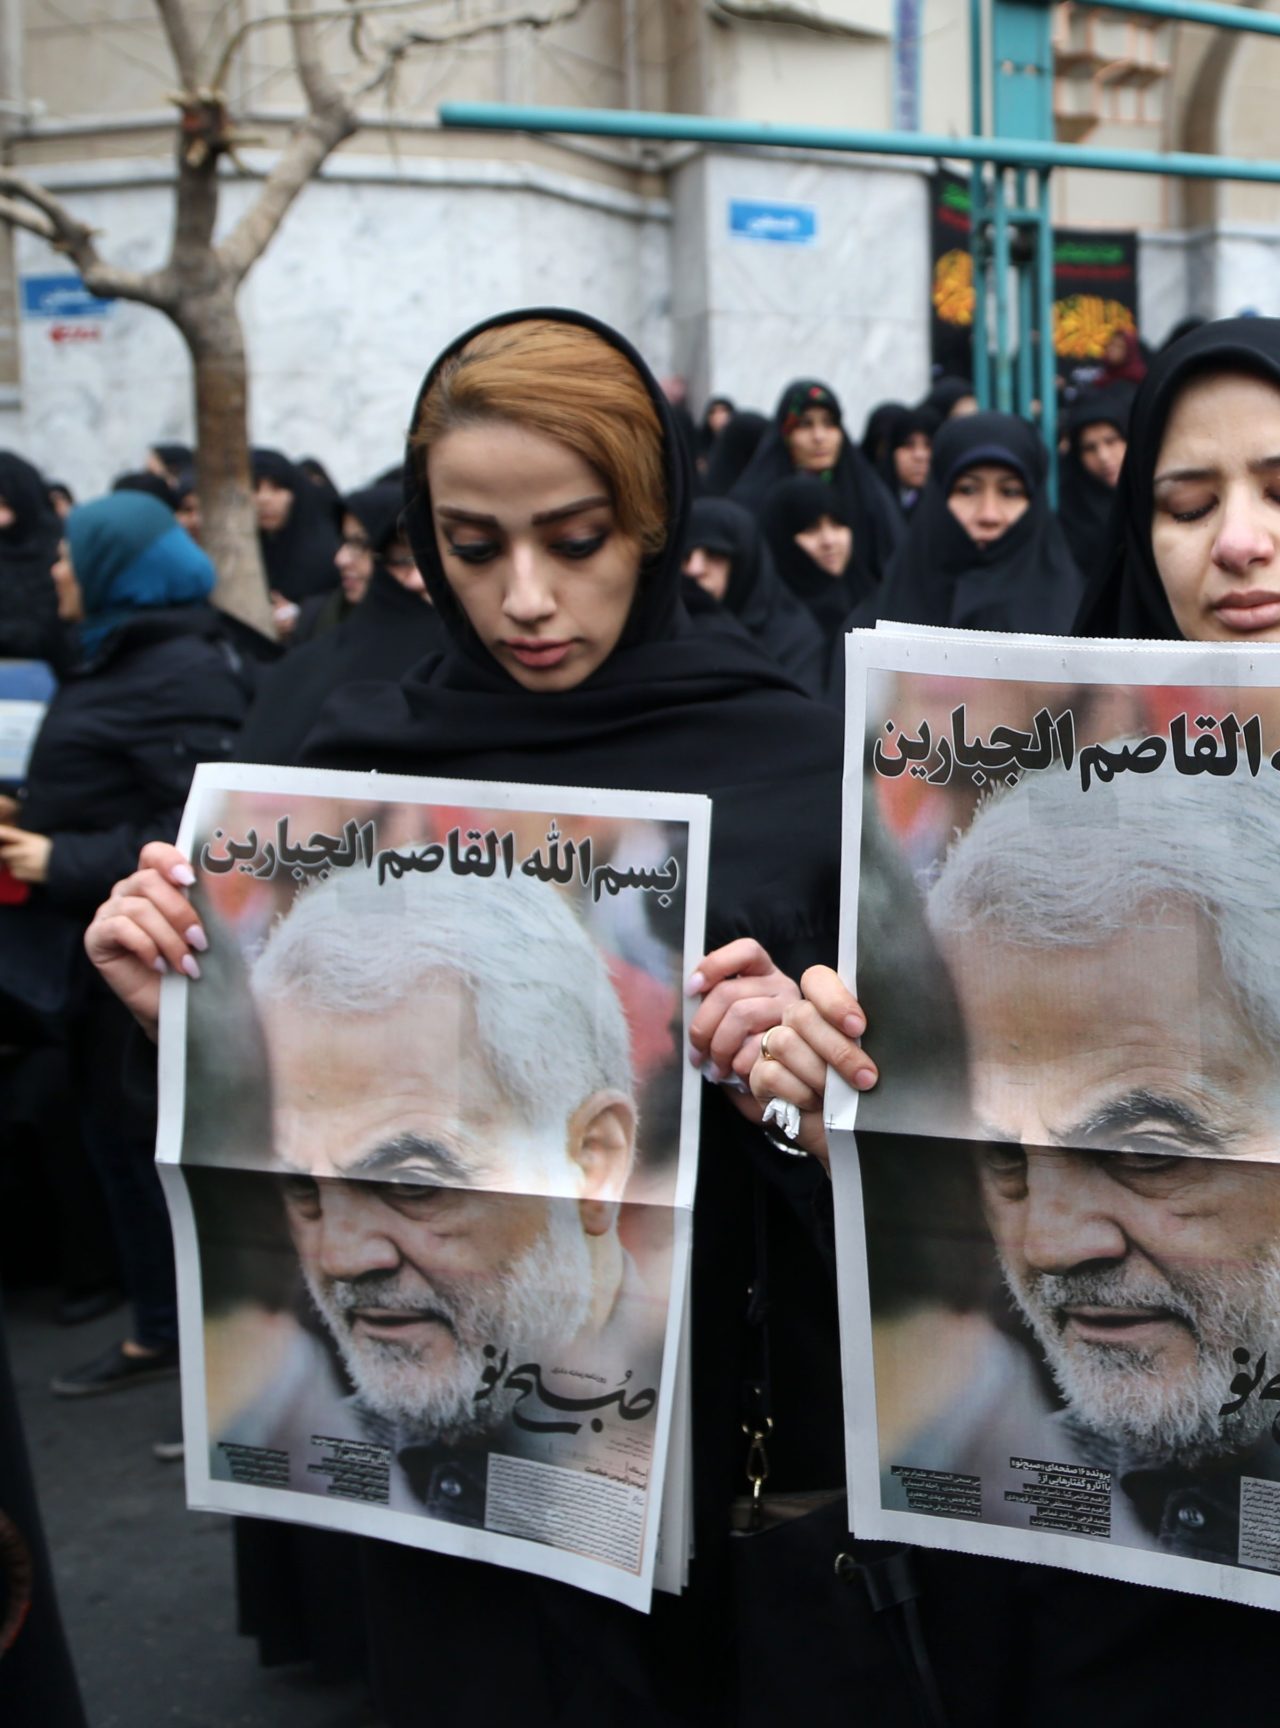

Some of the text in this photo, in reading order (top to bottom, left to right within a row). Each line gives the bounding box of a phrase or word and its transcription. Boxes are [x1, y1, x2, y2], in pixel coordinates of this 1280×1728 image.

[873, 704, 1075, 786] الجبارین
[1079, 712, 1261, 792] القاصم
[201, 816, 679, 907] بسم الله القاصم الجبارین
